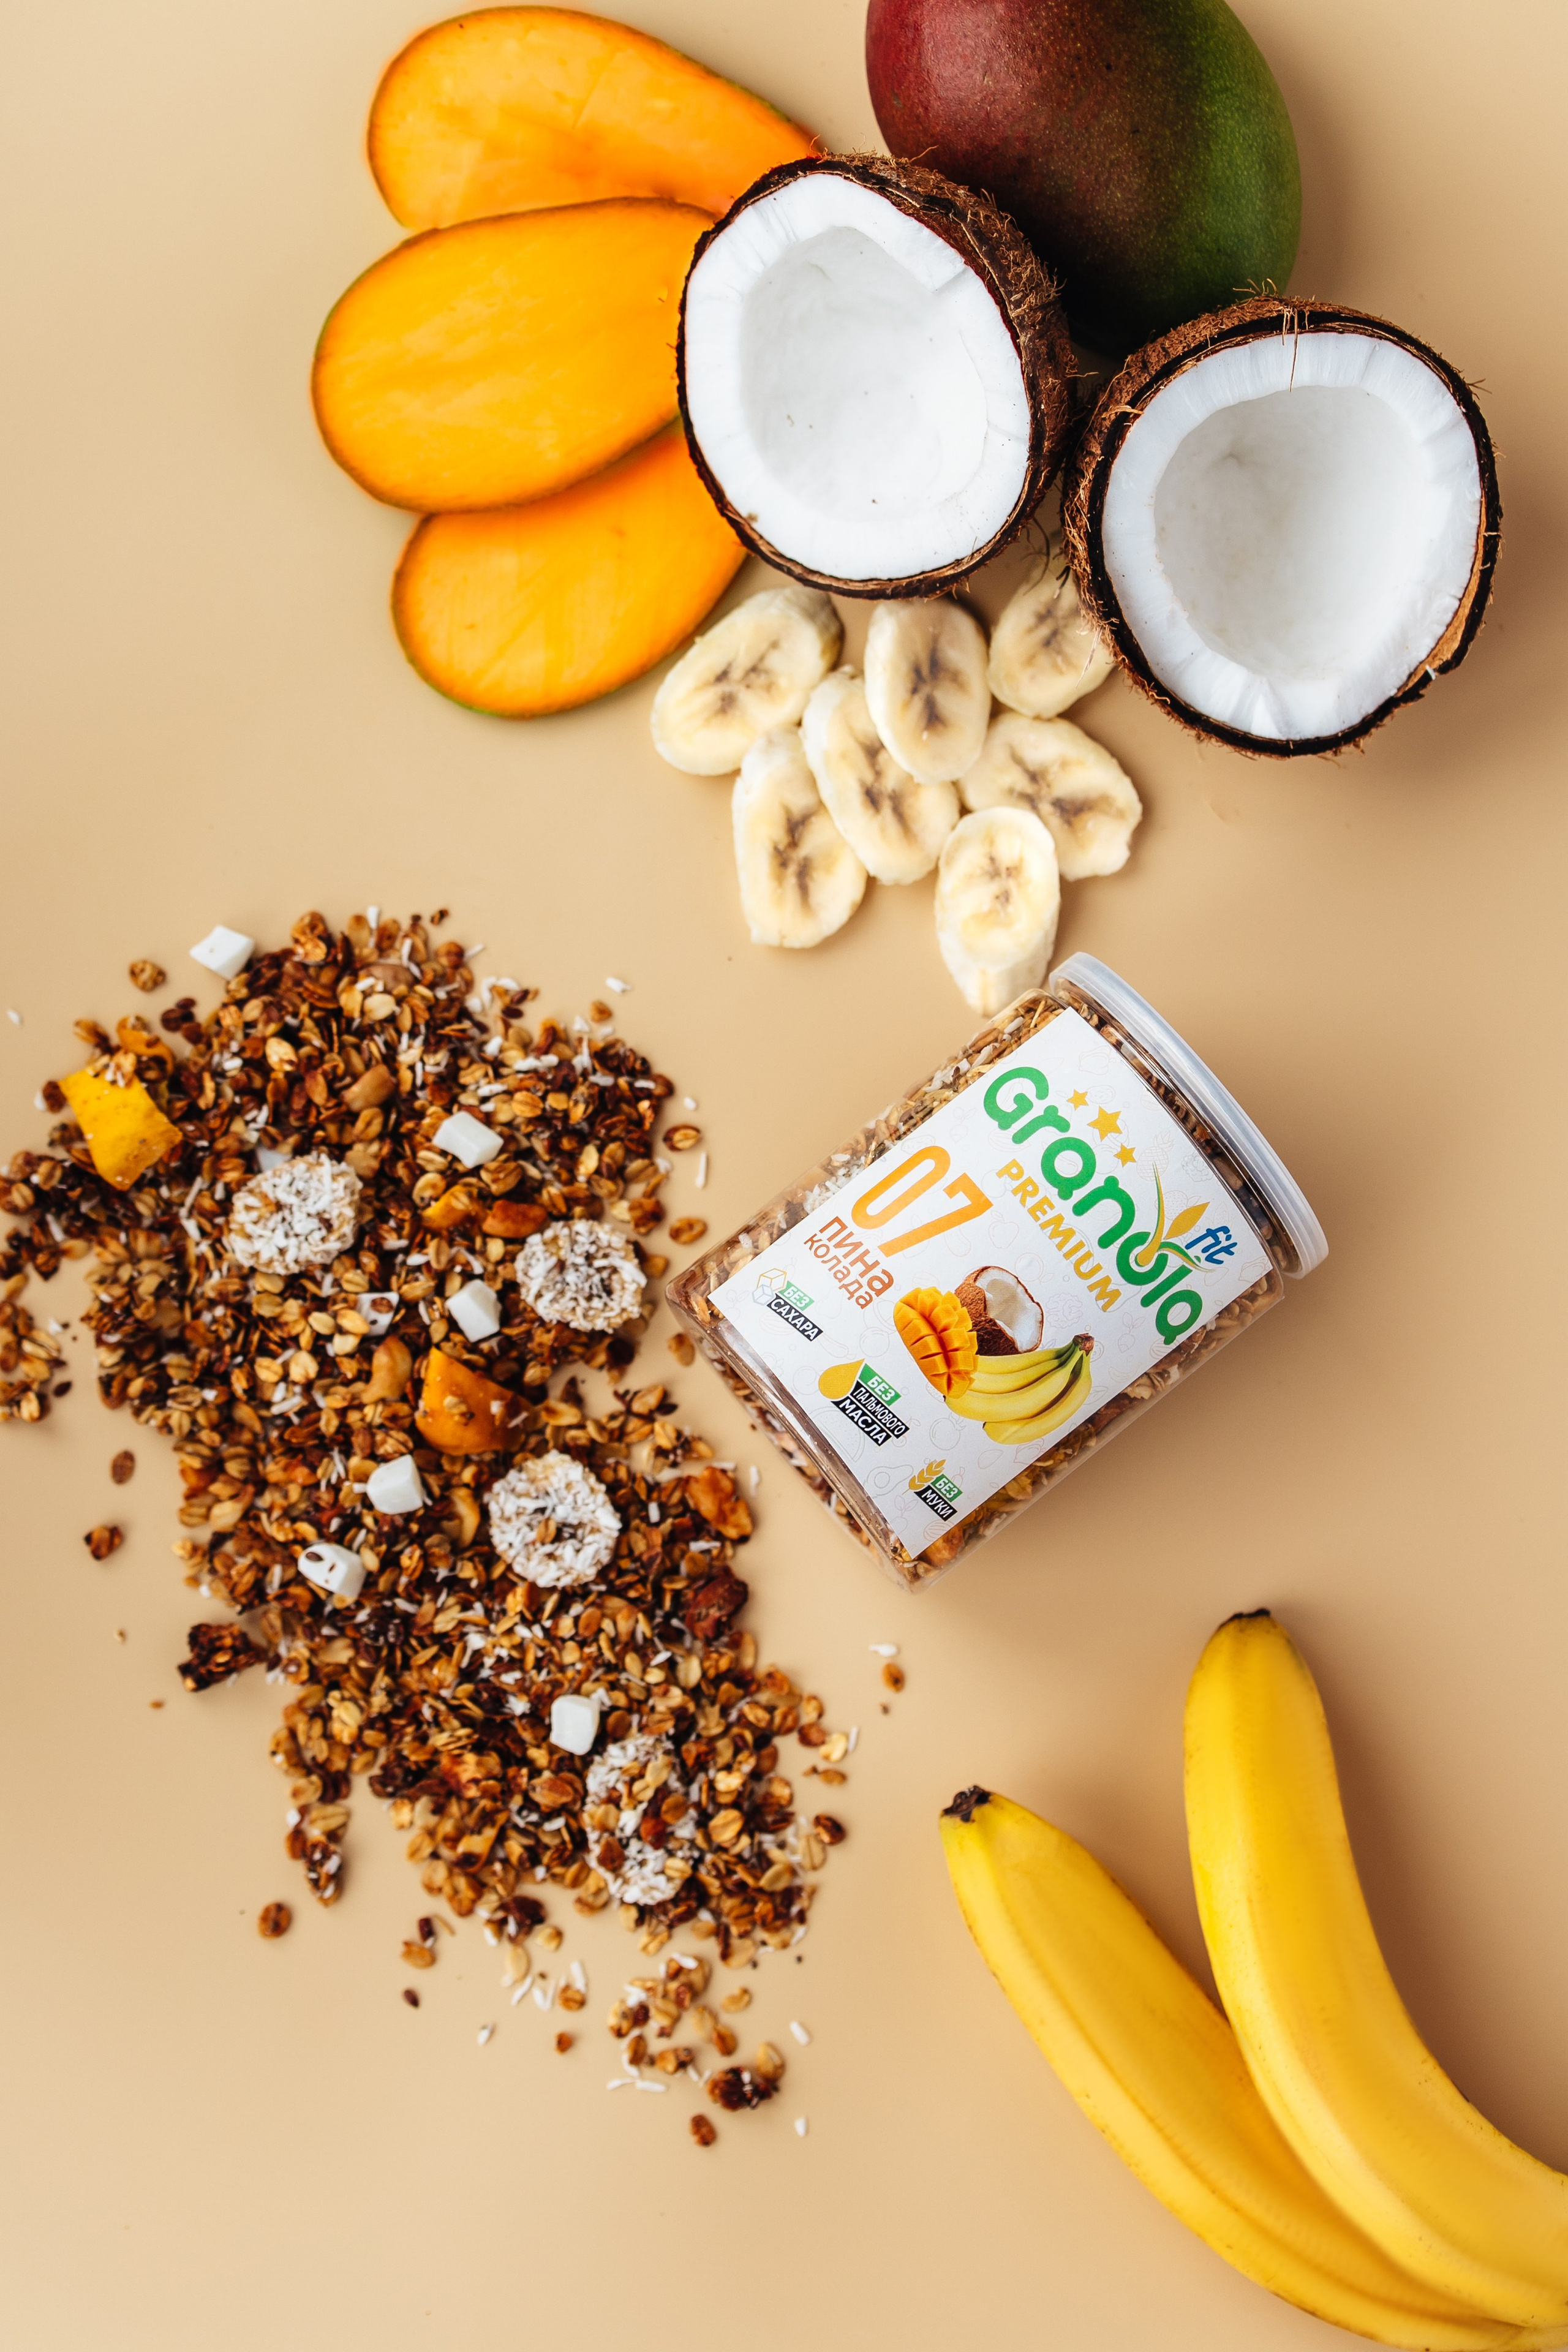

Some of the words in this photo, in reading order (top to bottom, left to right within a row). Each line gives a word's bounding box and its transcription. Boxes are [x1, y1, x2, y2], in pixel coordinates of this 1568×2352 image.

[852, 1145, 993, 1257] 07
[984, 1067, 1204, 1346] Granola
[997, 1158, 1121, 1312] PREMIUM
[1185, 1225, 1237, 1265] fit
[804, 1233, 873, 1310] колада
[783, 1286, 810, 1307] БЕЗ
[771, 1298, 819, 1340] САХАРА
[867, 1376, 895, 1400] БЕЗ
[839, 1399, 888, 1444] МАСЛА
[854, 1387, 906, 1435] ПАЛЬМОВОГО
[921, 1488, 954, 1518] МУКИ
[935, 1477, 959, 1499] БЕЗ
